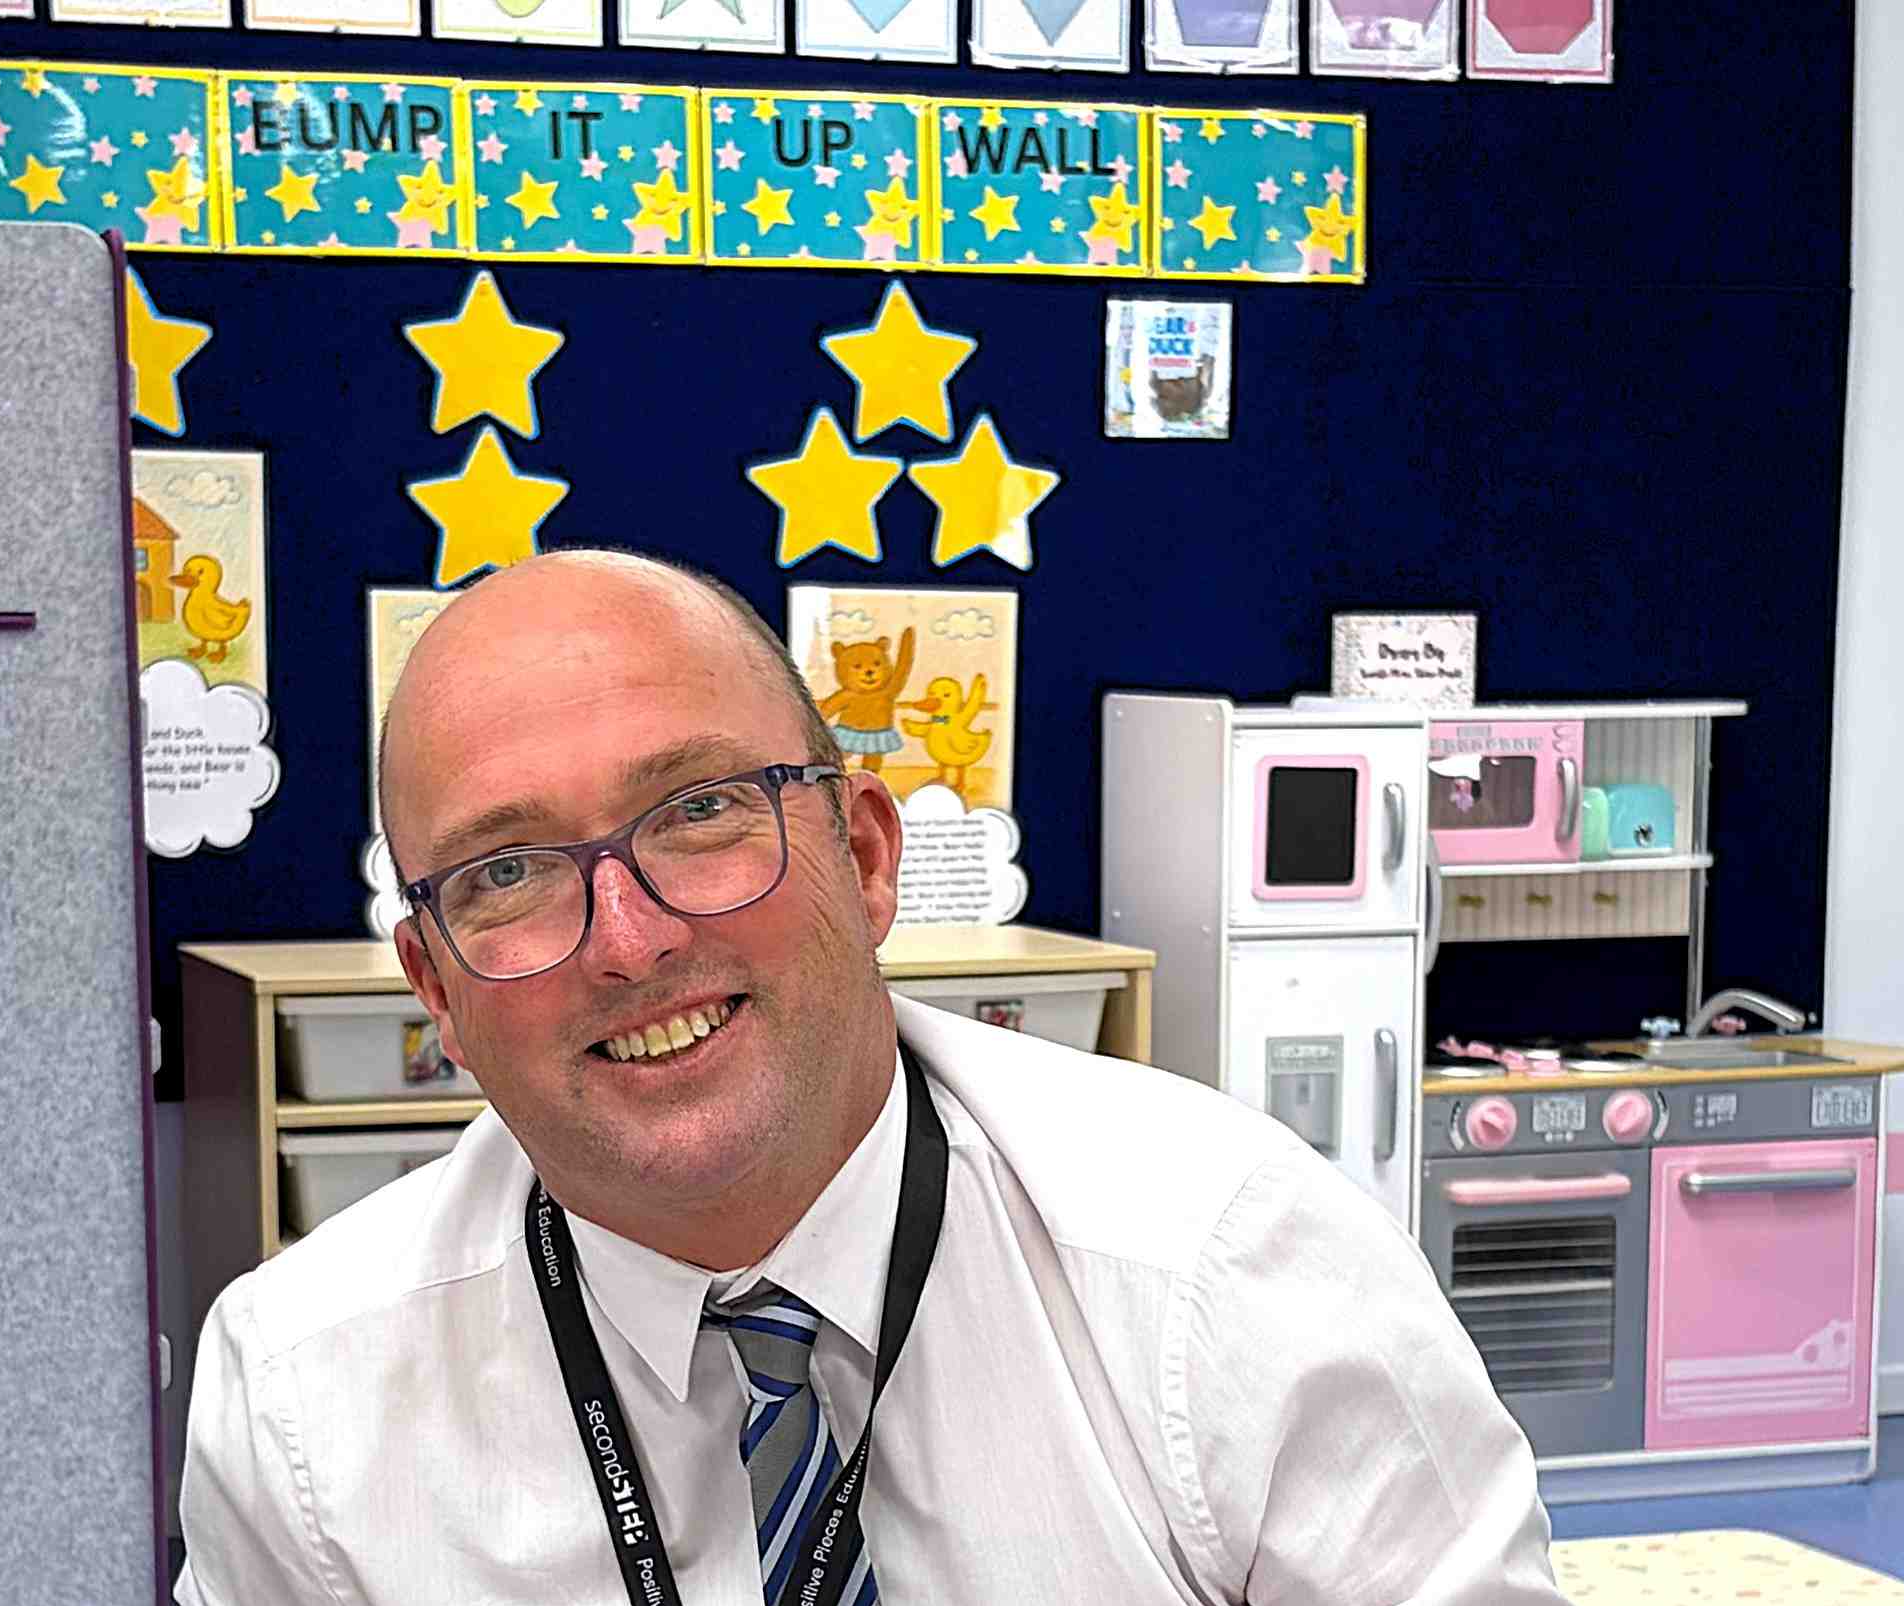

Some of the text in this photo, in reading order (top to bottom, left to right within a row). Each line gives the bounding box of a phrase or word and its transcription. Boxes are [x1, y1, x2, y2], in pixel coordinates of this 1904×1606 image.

[548, 110, 604, 161] IT
[772, 117, 854, 169] UP
[958, 124, 1119, 176] WALL
[537, 1204, 561, 1288] Education
[812, 1508, 845, 1564] Pieces
